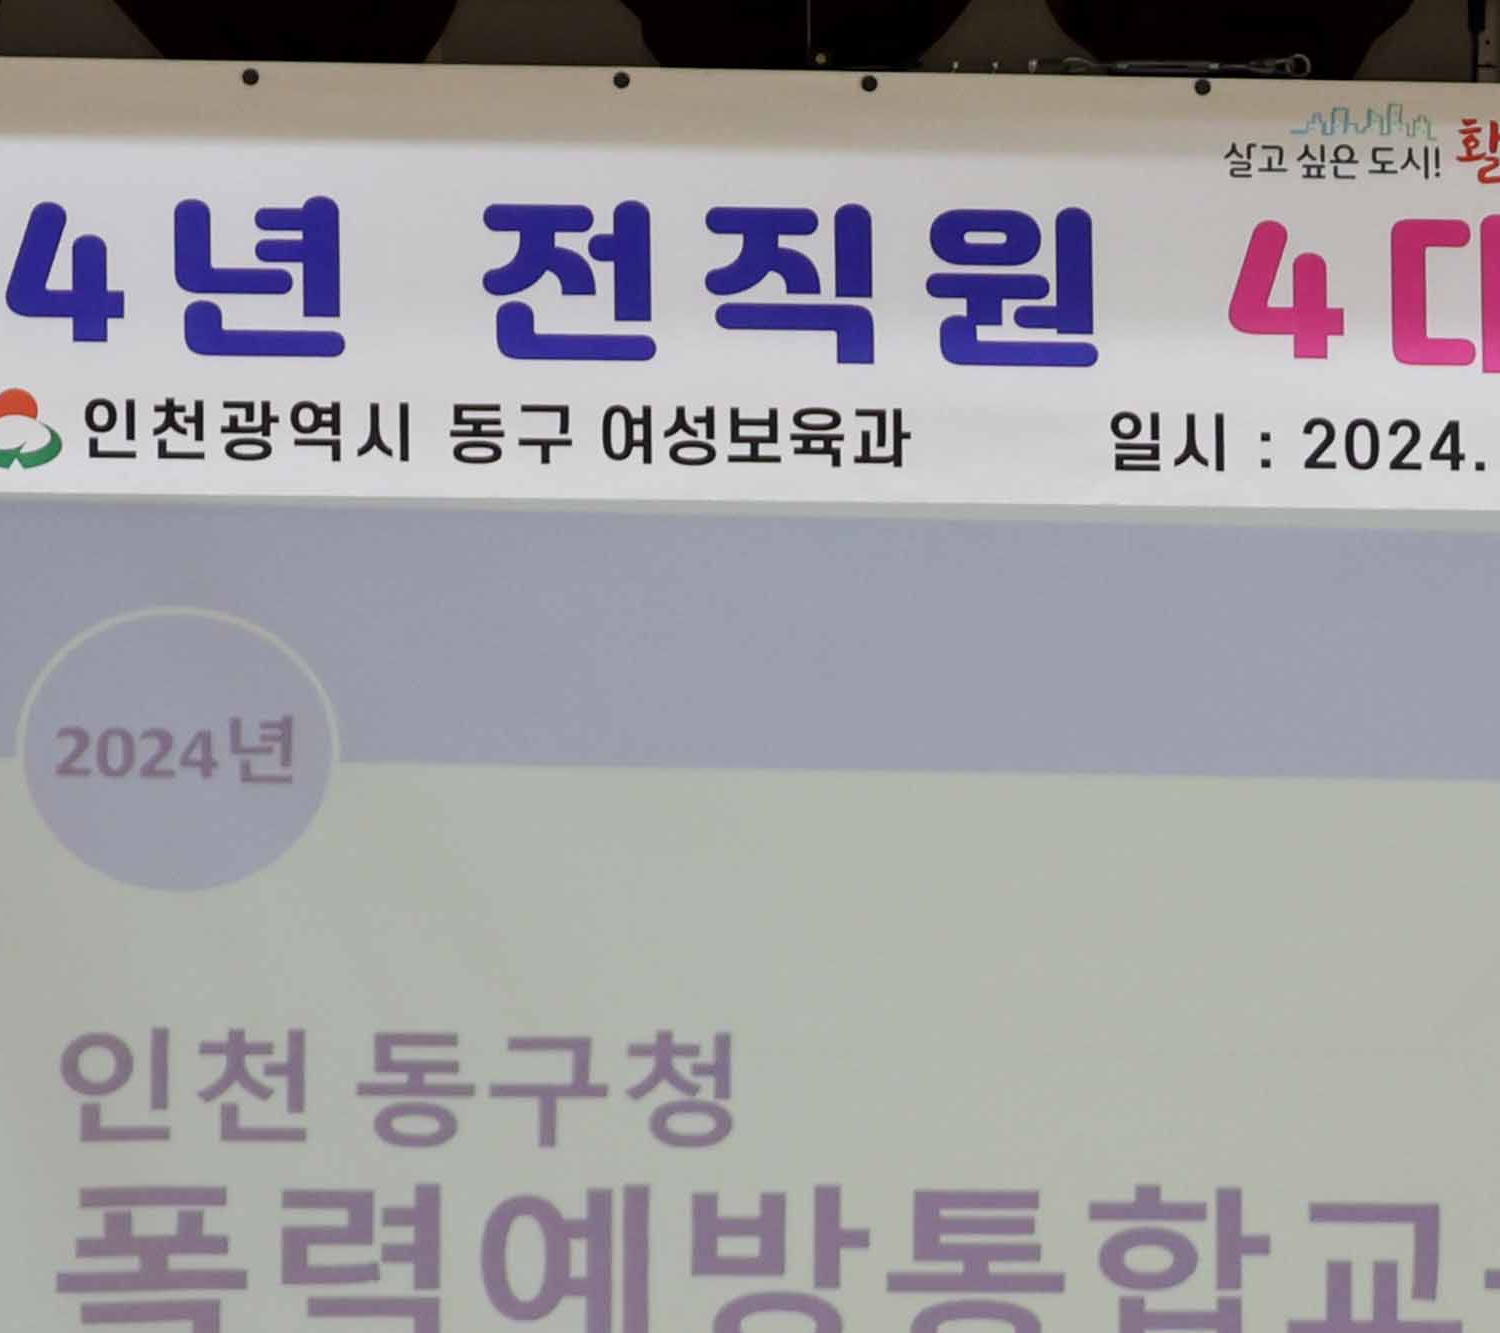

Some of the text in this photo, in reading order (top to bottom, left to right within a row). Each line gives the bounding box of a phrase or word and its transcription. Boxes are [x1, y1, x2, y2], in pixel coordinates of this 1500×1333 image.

[1224, 142, 1288, 178] 살고
[1296, 144, 1359, 179] 싶은
[1368, 142, 1442, 180] 도시!
[482, 200, 1098, 367] 전직원
[85, 397, 911, 468] 인천광역시 동구 여성보육과
[1110, 411, 1224, 472] 일시
[1303, 418, 1485, 471] 2024.
[56, 716, 294, 784] 2024년
[61, 1028, 732, 1147] 인천 동구청
